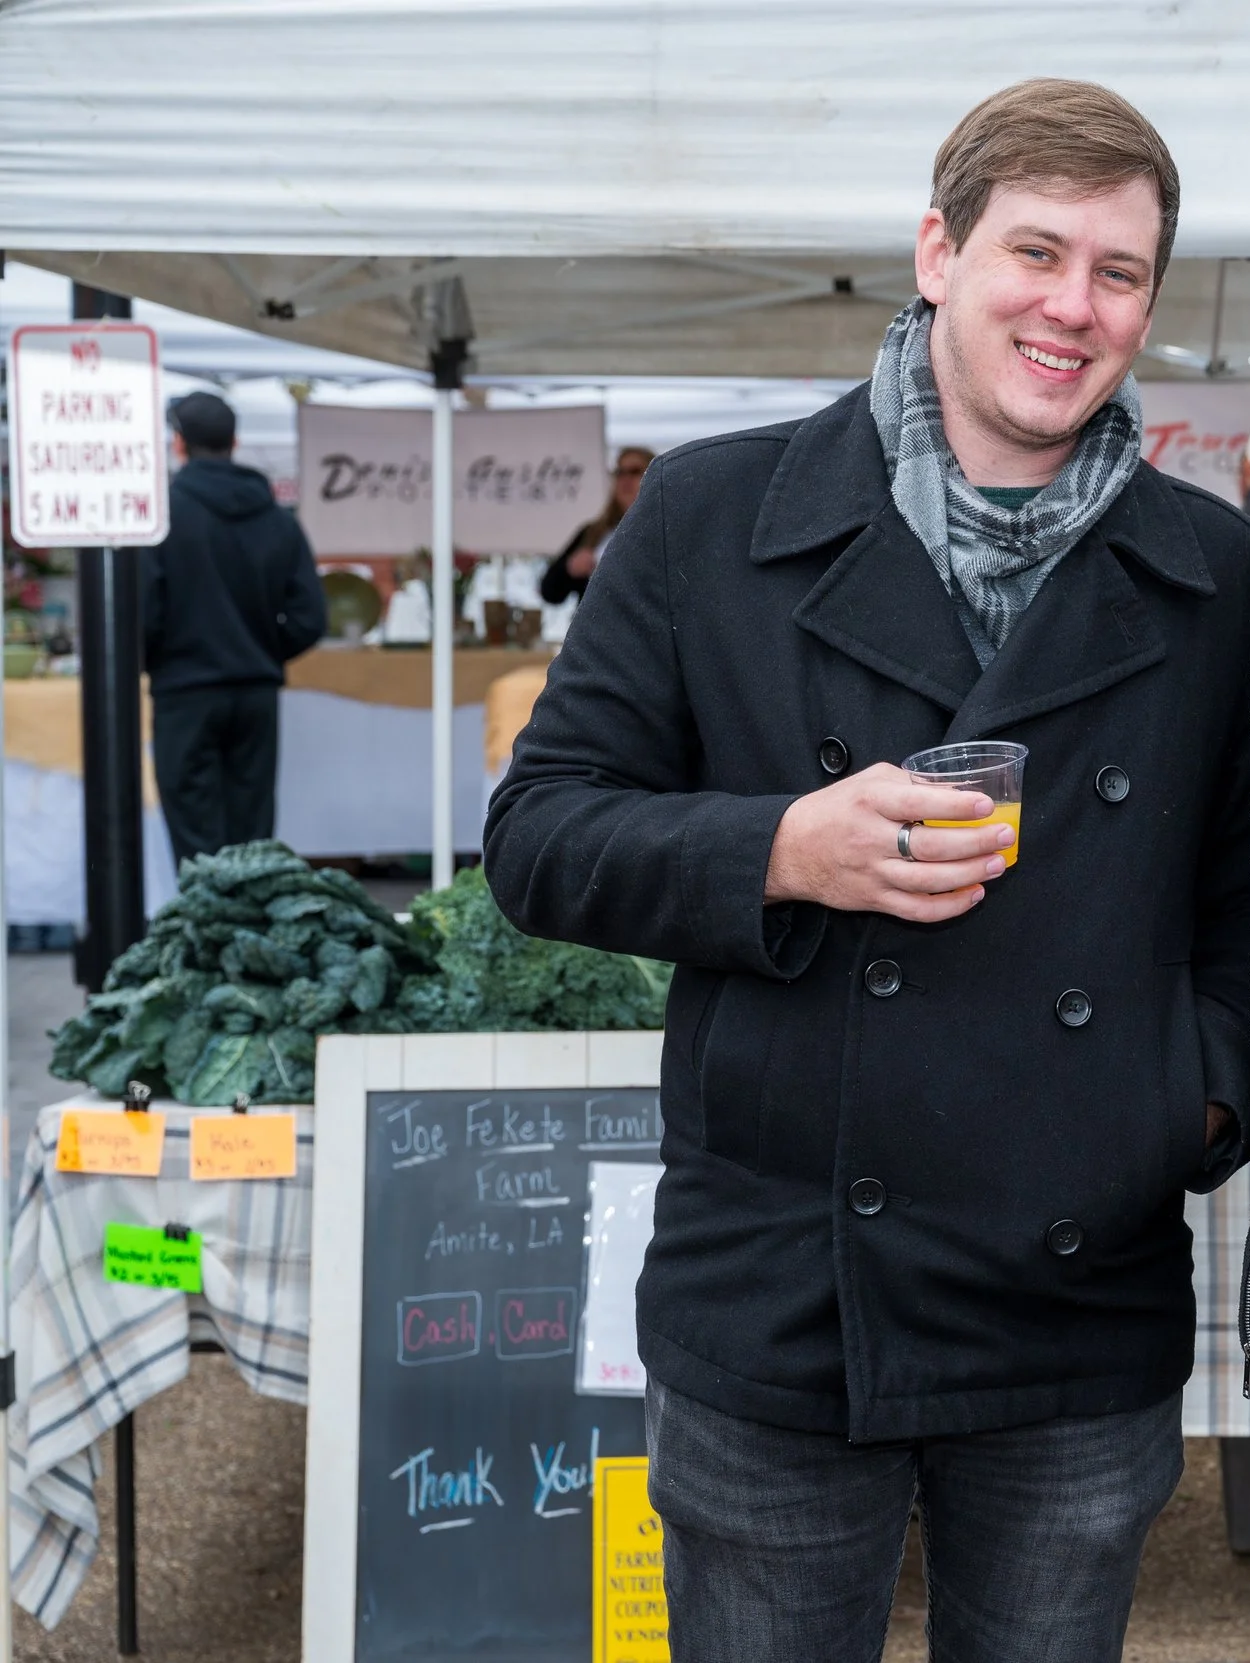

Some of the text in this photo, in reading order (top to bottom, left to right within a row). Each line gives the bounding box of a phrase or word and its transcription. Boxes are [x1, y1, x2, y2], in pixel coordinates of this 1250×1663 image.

[70, 340, 102, 373] NO
[42, 390, 133, 423] PARKING
[29, 441, 150, 476] SATURDAYS
[29, 491, 42, 525] 5
[52, 492, 80, 523] AM
[121, 491, 151, 523] PM
[210, 1132, 256, 1153] Kale
[388, 1099, 448, 1155] Joe
[466, 1098, 566, 1147] Fekete
[474, 1161, 561, 1201] Farm
[527, 1216, 563, 1249] LA
[503, 1299, 568, 1344] Card
[389, 1447, 505, 1517] Thank
